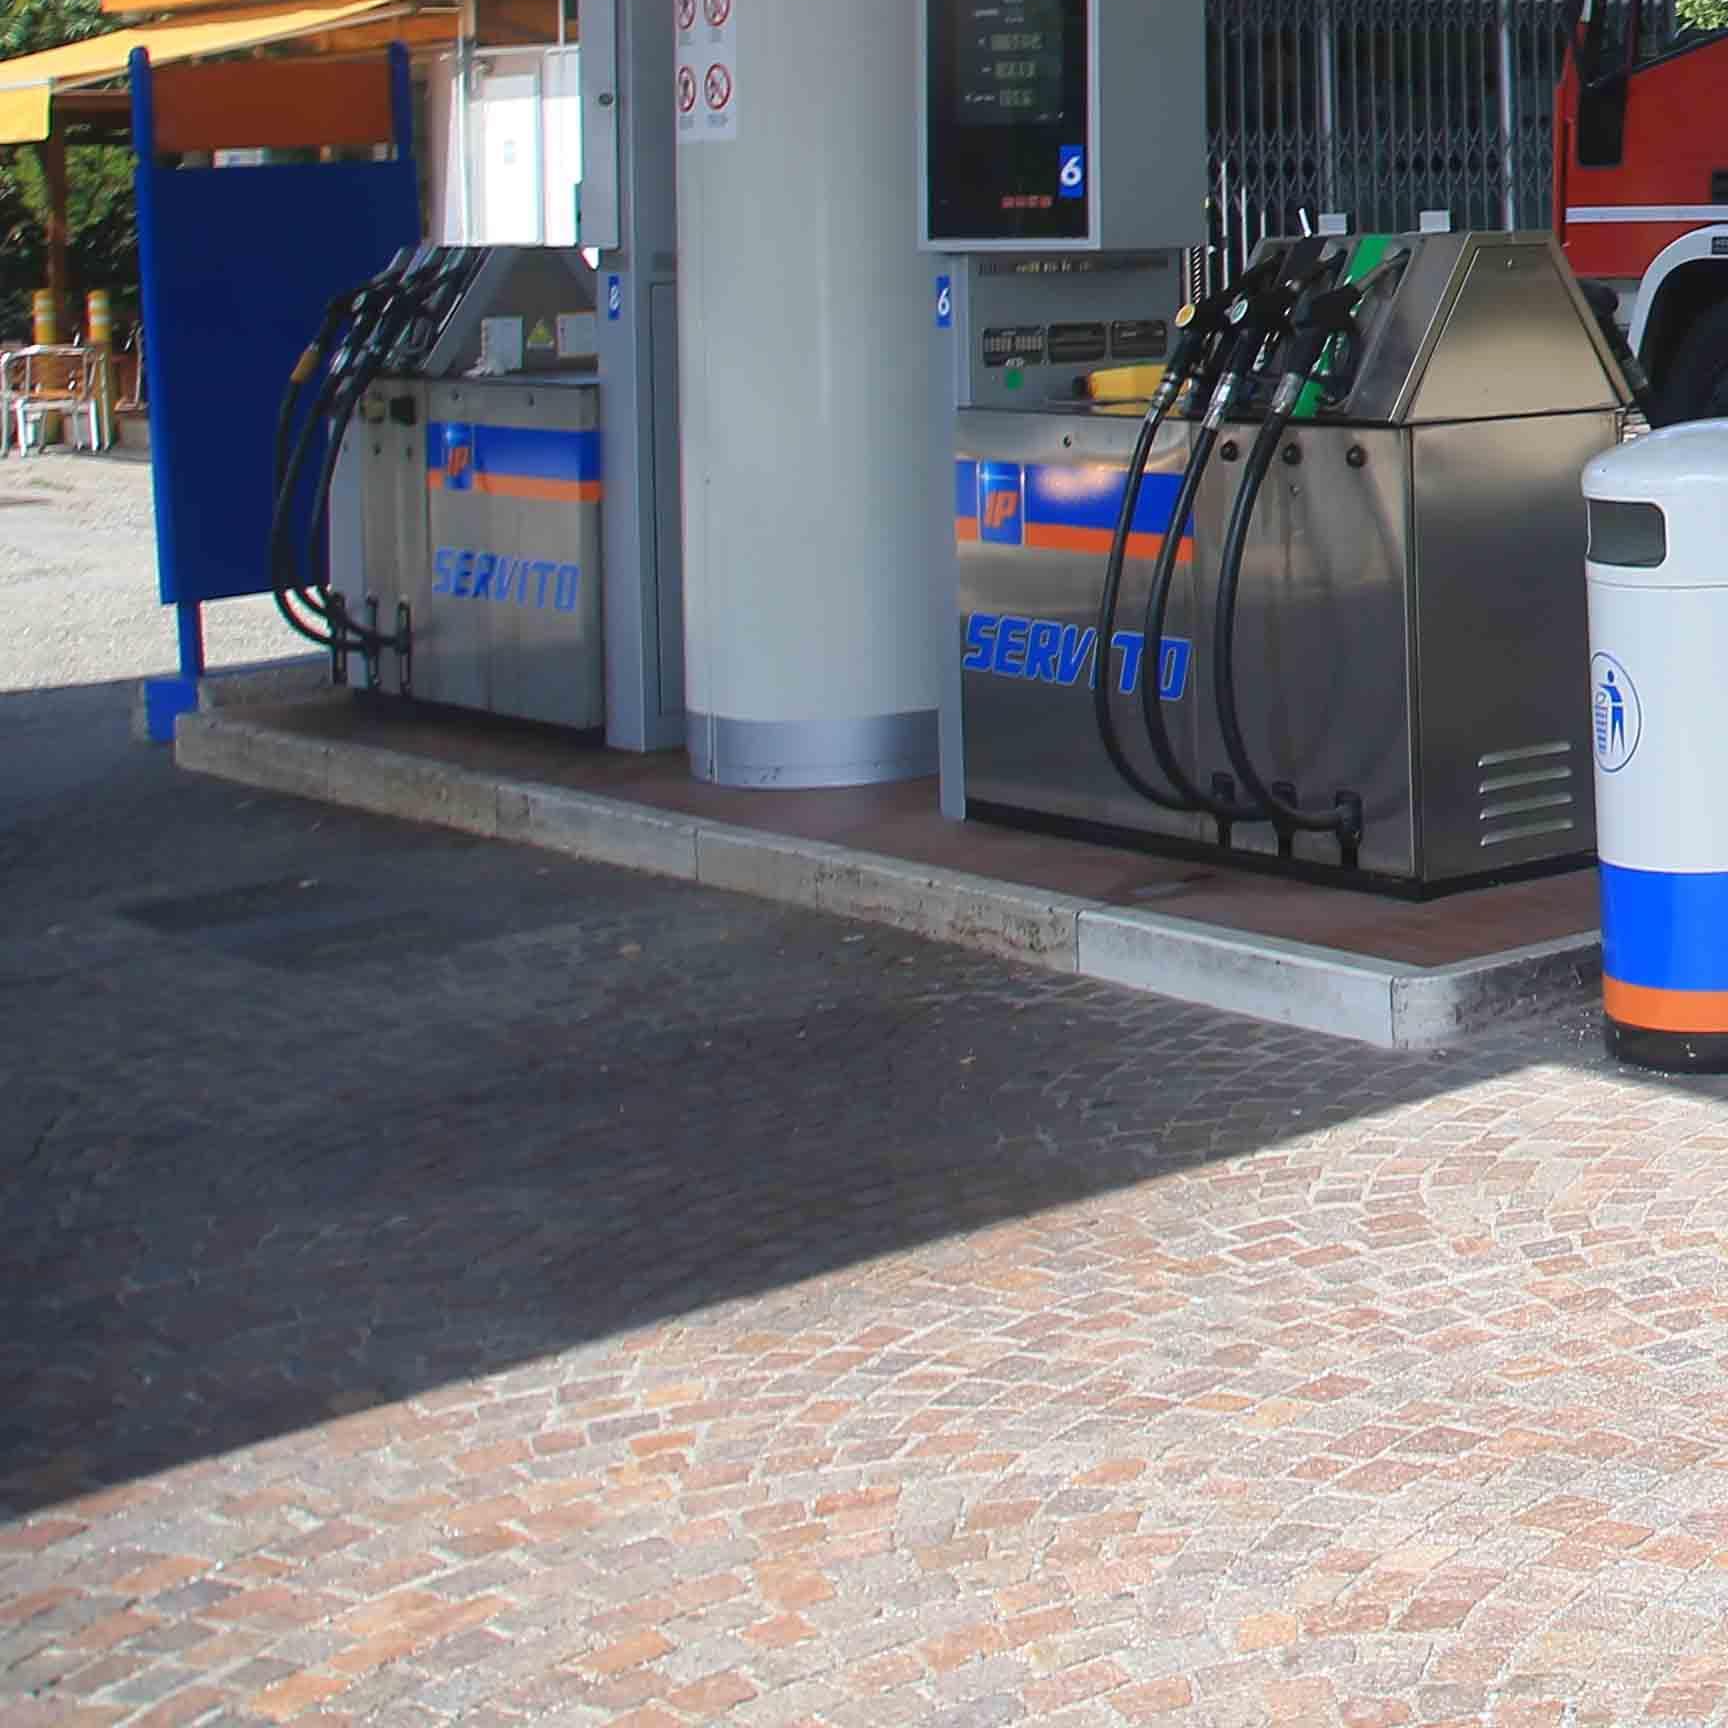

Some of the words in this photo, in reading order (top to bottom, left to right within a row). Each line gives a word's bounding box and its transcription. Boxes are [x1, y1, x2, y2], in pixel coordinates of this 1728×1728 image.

[1060, 155, 1083, 187] 6
[936, 287, 951, 317] 6
[984, 490, 1020, 529] IP
[432, 544, 580, 613] SERVITO
[963, 610, 1192, 701] SERVTO
